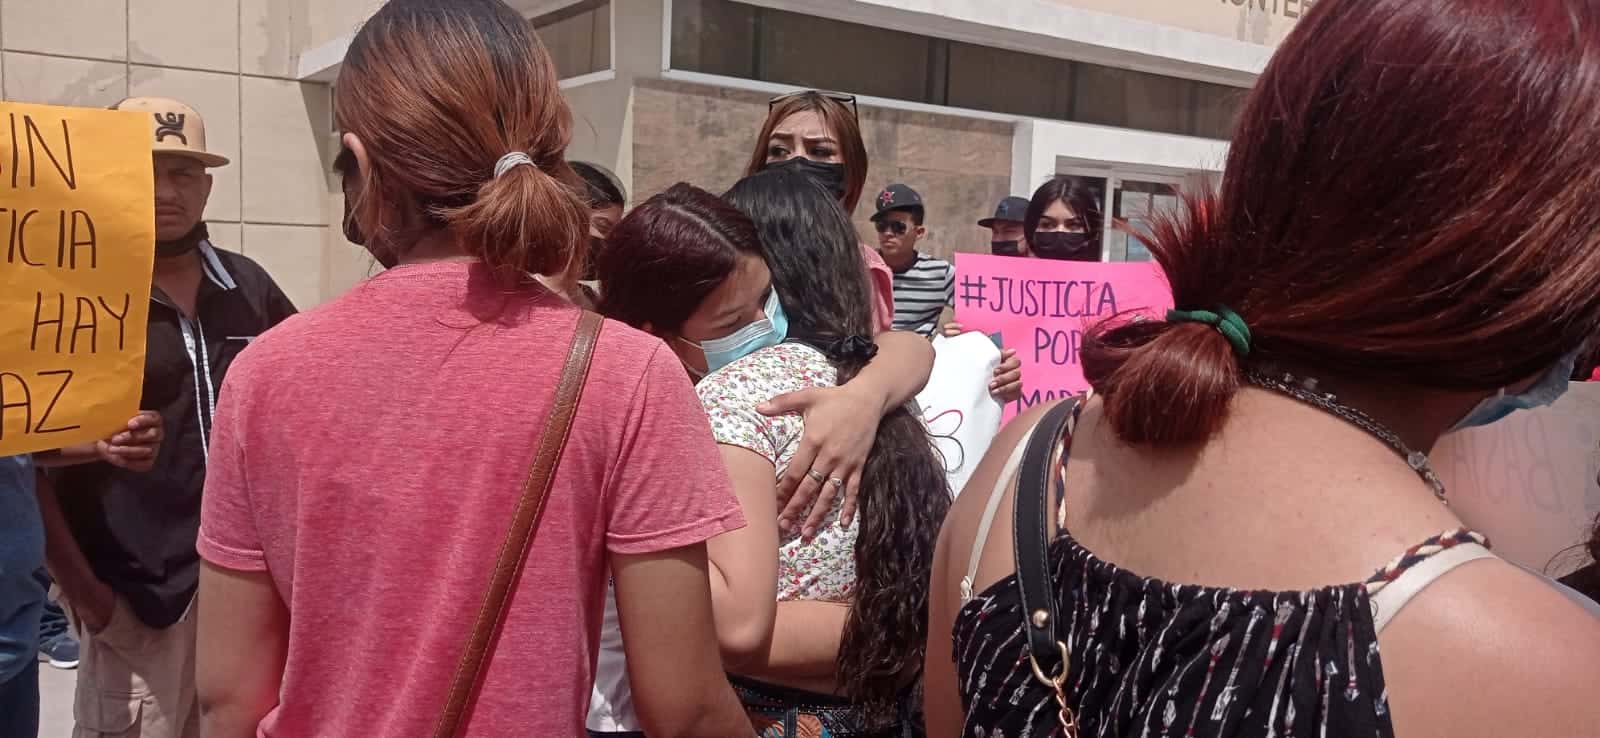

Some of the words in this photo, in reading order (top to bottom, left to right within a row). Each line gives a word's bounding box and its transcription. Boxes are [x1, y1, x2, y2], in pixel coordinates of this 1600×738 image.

[0, 112, 77, 190] IN
[30, 291, 130, 354] HAY
[959, 274, 1118, 318] #JUSTICIA
